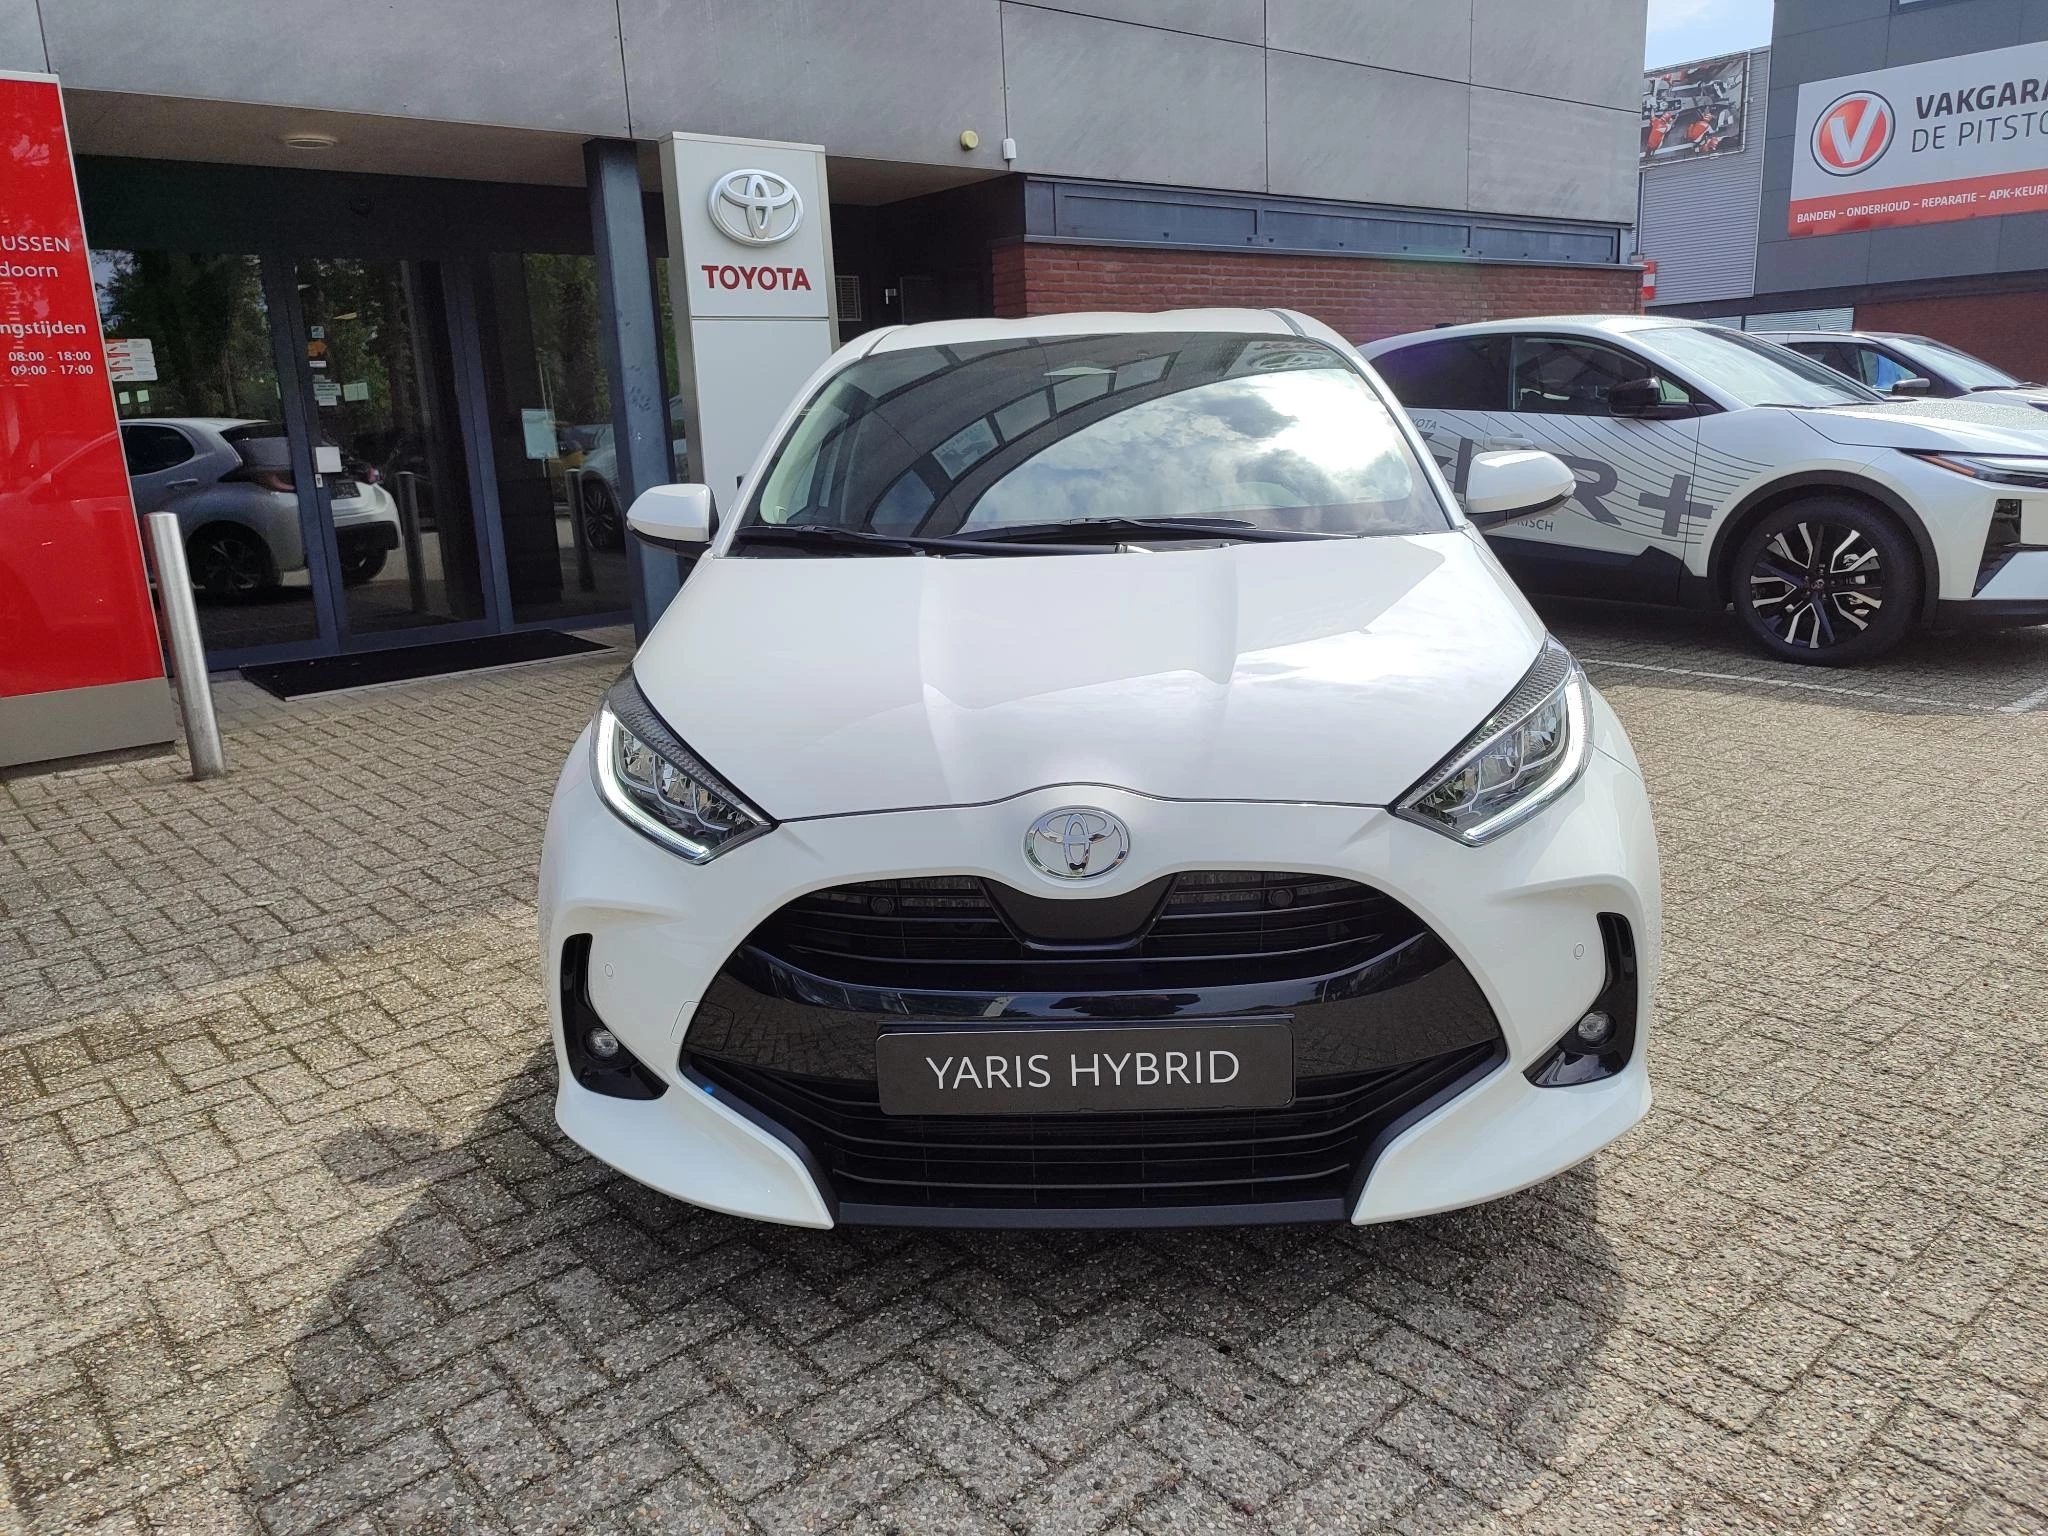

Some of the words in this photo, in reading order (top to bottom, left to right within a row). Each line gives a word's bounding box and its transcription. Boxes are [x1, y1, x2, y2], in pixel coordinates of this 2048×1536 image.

[1912, 125, 1946, 153] DE
[1796, 209, 1836, 224] BANDEN
[1846, 200, 1911, 217] ONDERHOUD
[1922, 192, 1977, 209] REPARATIE
[1988, 183, 2047, 200] APK-KEURI
[0, 235, 71, 252] USSEN
[0, 260, 59, 277] doorn
[701, 265, 812, 291] TOYOTA
[0, 321, 86, 338] ngstijden
[8, 351, 45, 361] 08:00
[57, 351, 91, 361] 18:00
[11, 365, 47, 375] 09:00
[59, 365, 94, 375] 17:00
[926, 1054, 1051, 1089] YARIS
[1070, 1050, 1240, 1087] HYBRID
